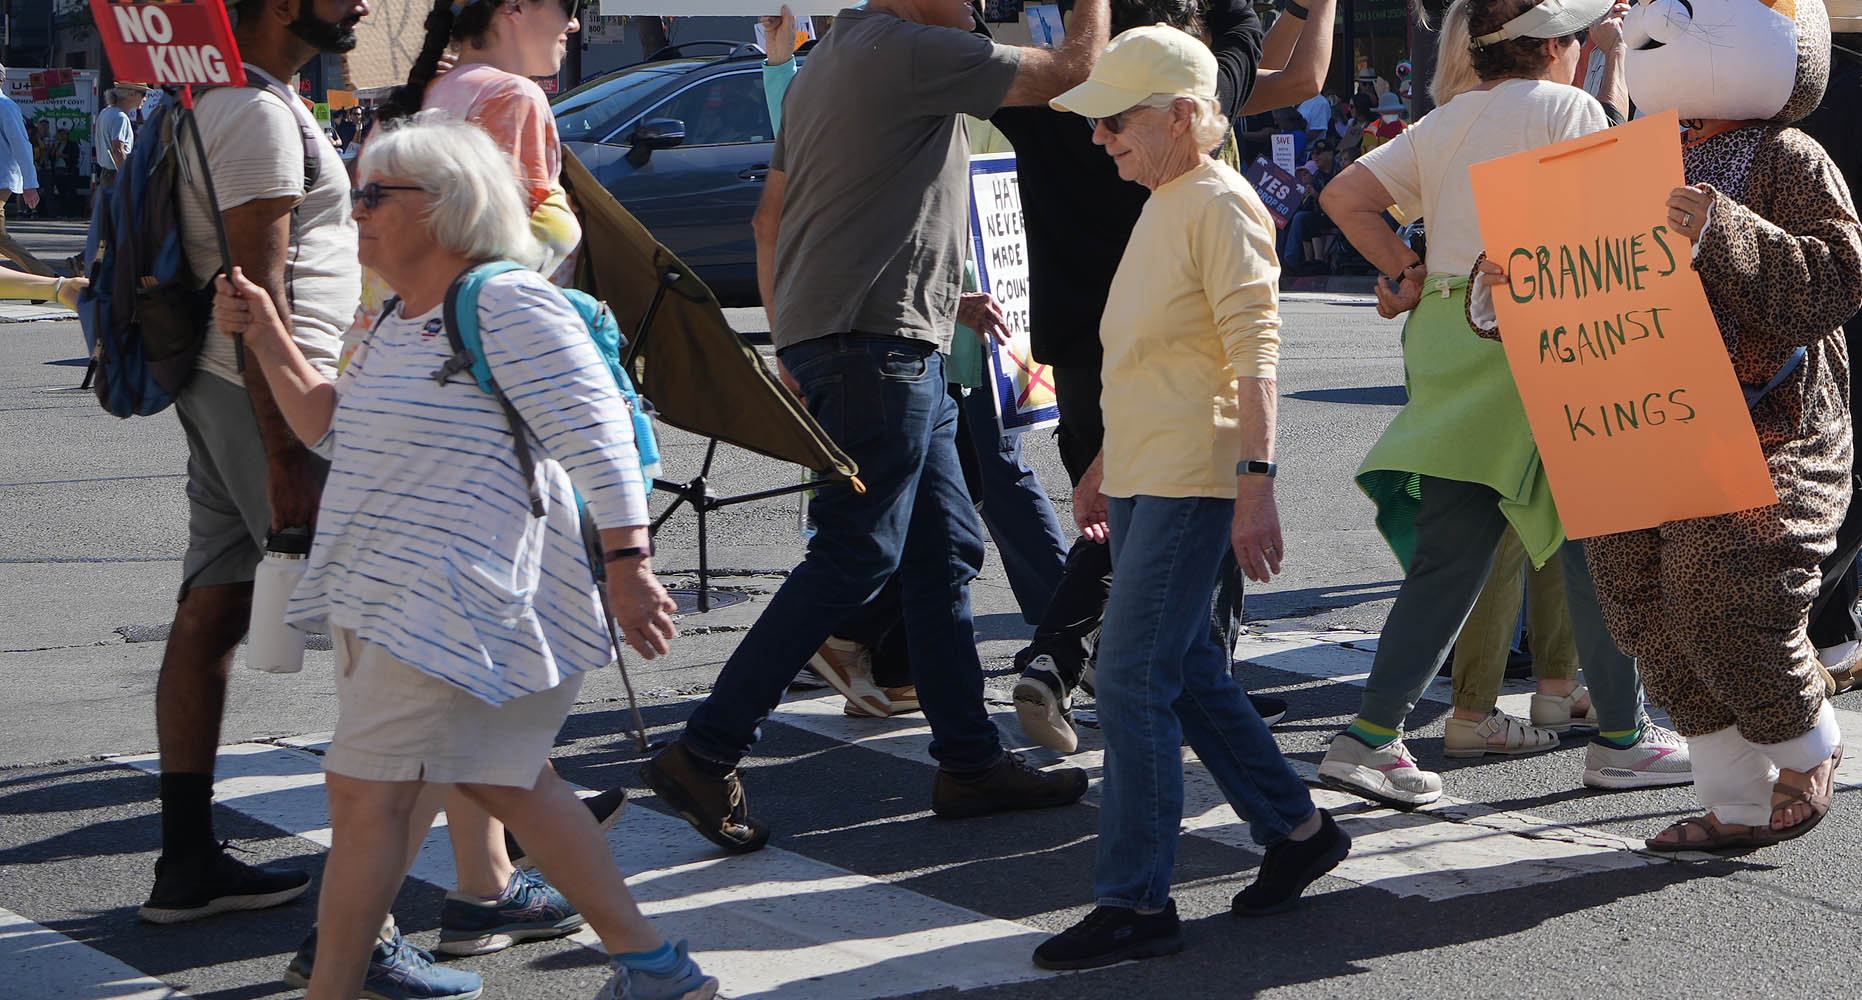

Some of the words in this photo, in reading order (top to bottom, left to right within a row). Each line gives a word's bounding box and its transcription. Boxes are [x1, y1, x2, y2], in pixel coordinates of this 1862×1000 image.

[112, 5, 173, 44] NO
[147, 45, 230, 83] KING
[1257, 171, 1291, 200] YES
[992, 242, 1023, 269] MADE
[1508, 226, 1676, 303] GRANNIES
[1540, 308, 1672, 365] AGAINST
[1564, 389, 1695, 441] KINGS
